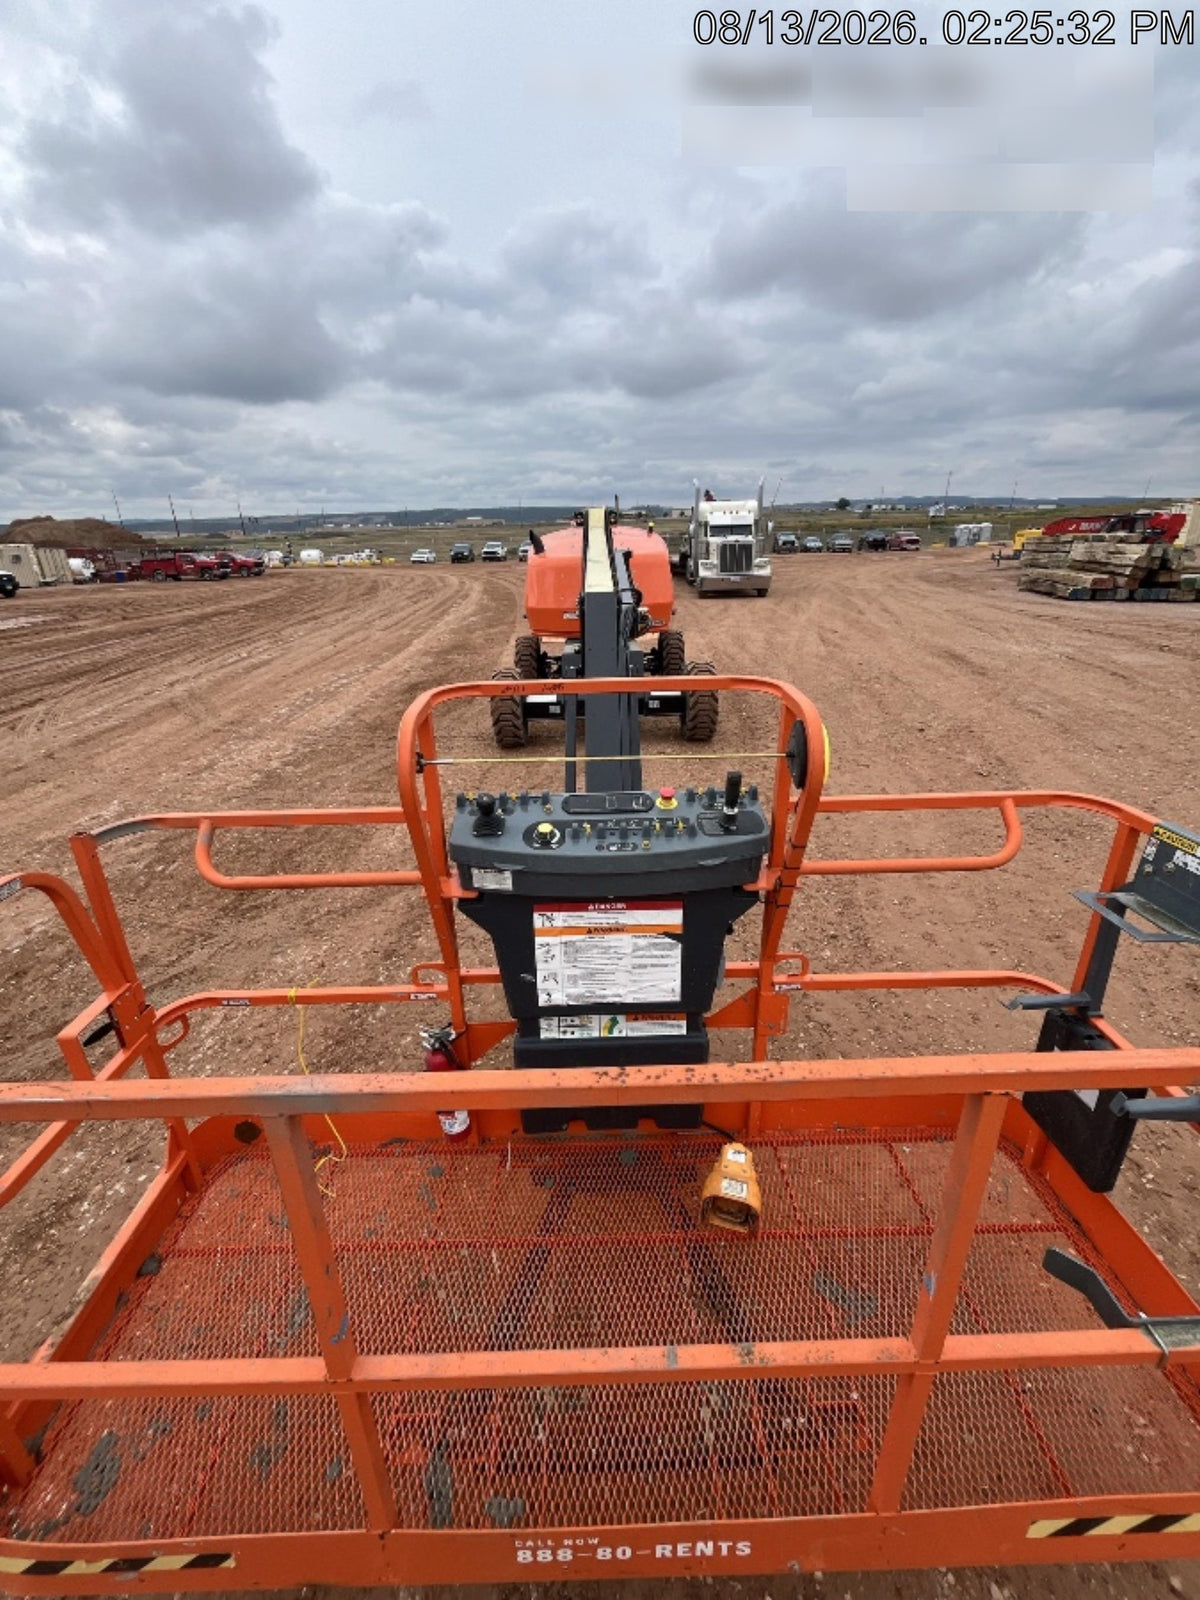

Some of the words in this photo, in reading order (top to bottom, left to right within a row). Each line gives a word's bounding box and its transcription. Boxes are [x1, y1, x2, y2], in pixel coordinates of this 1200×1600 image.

[514, 1538, 556, 1548] CALL
[563, 1536, 600, 1546] NOW
[516, 1540, 752, 1564] 888-80-RENTS
